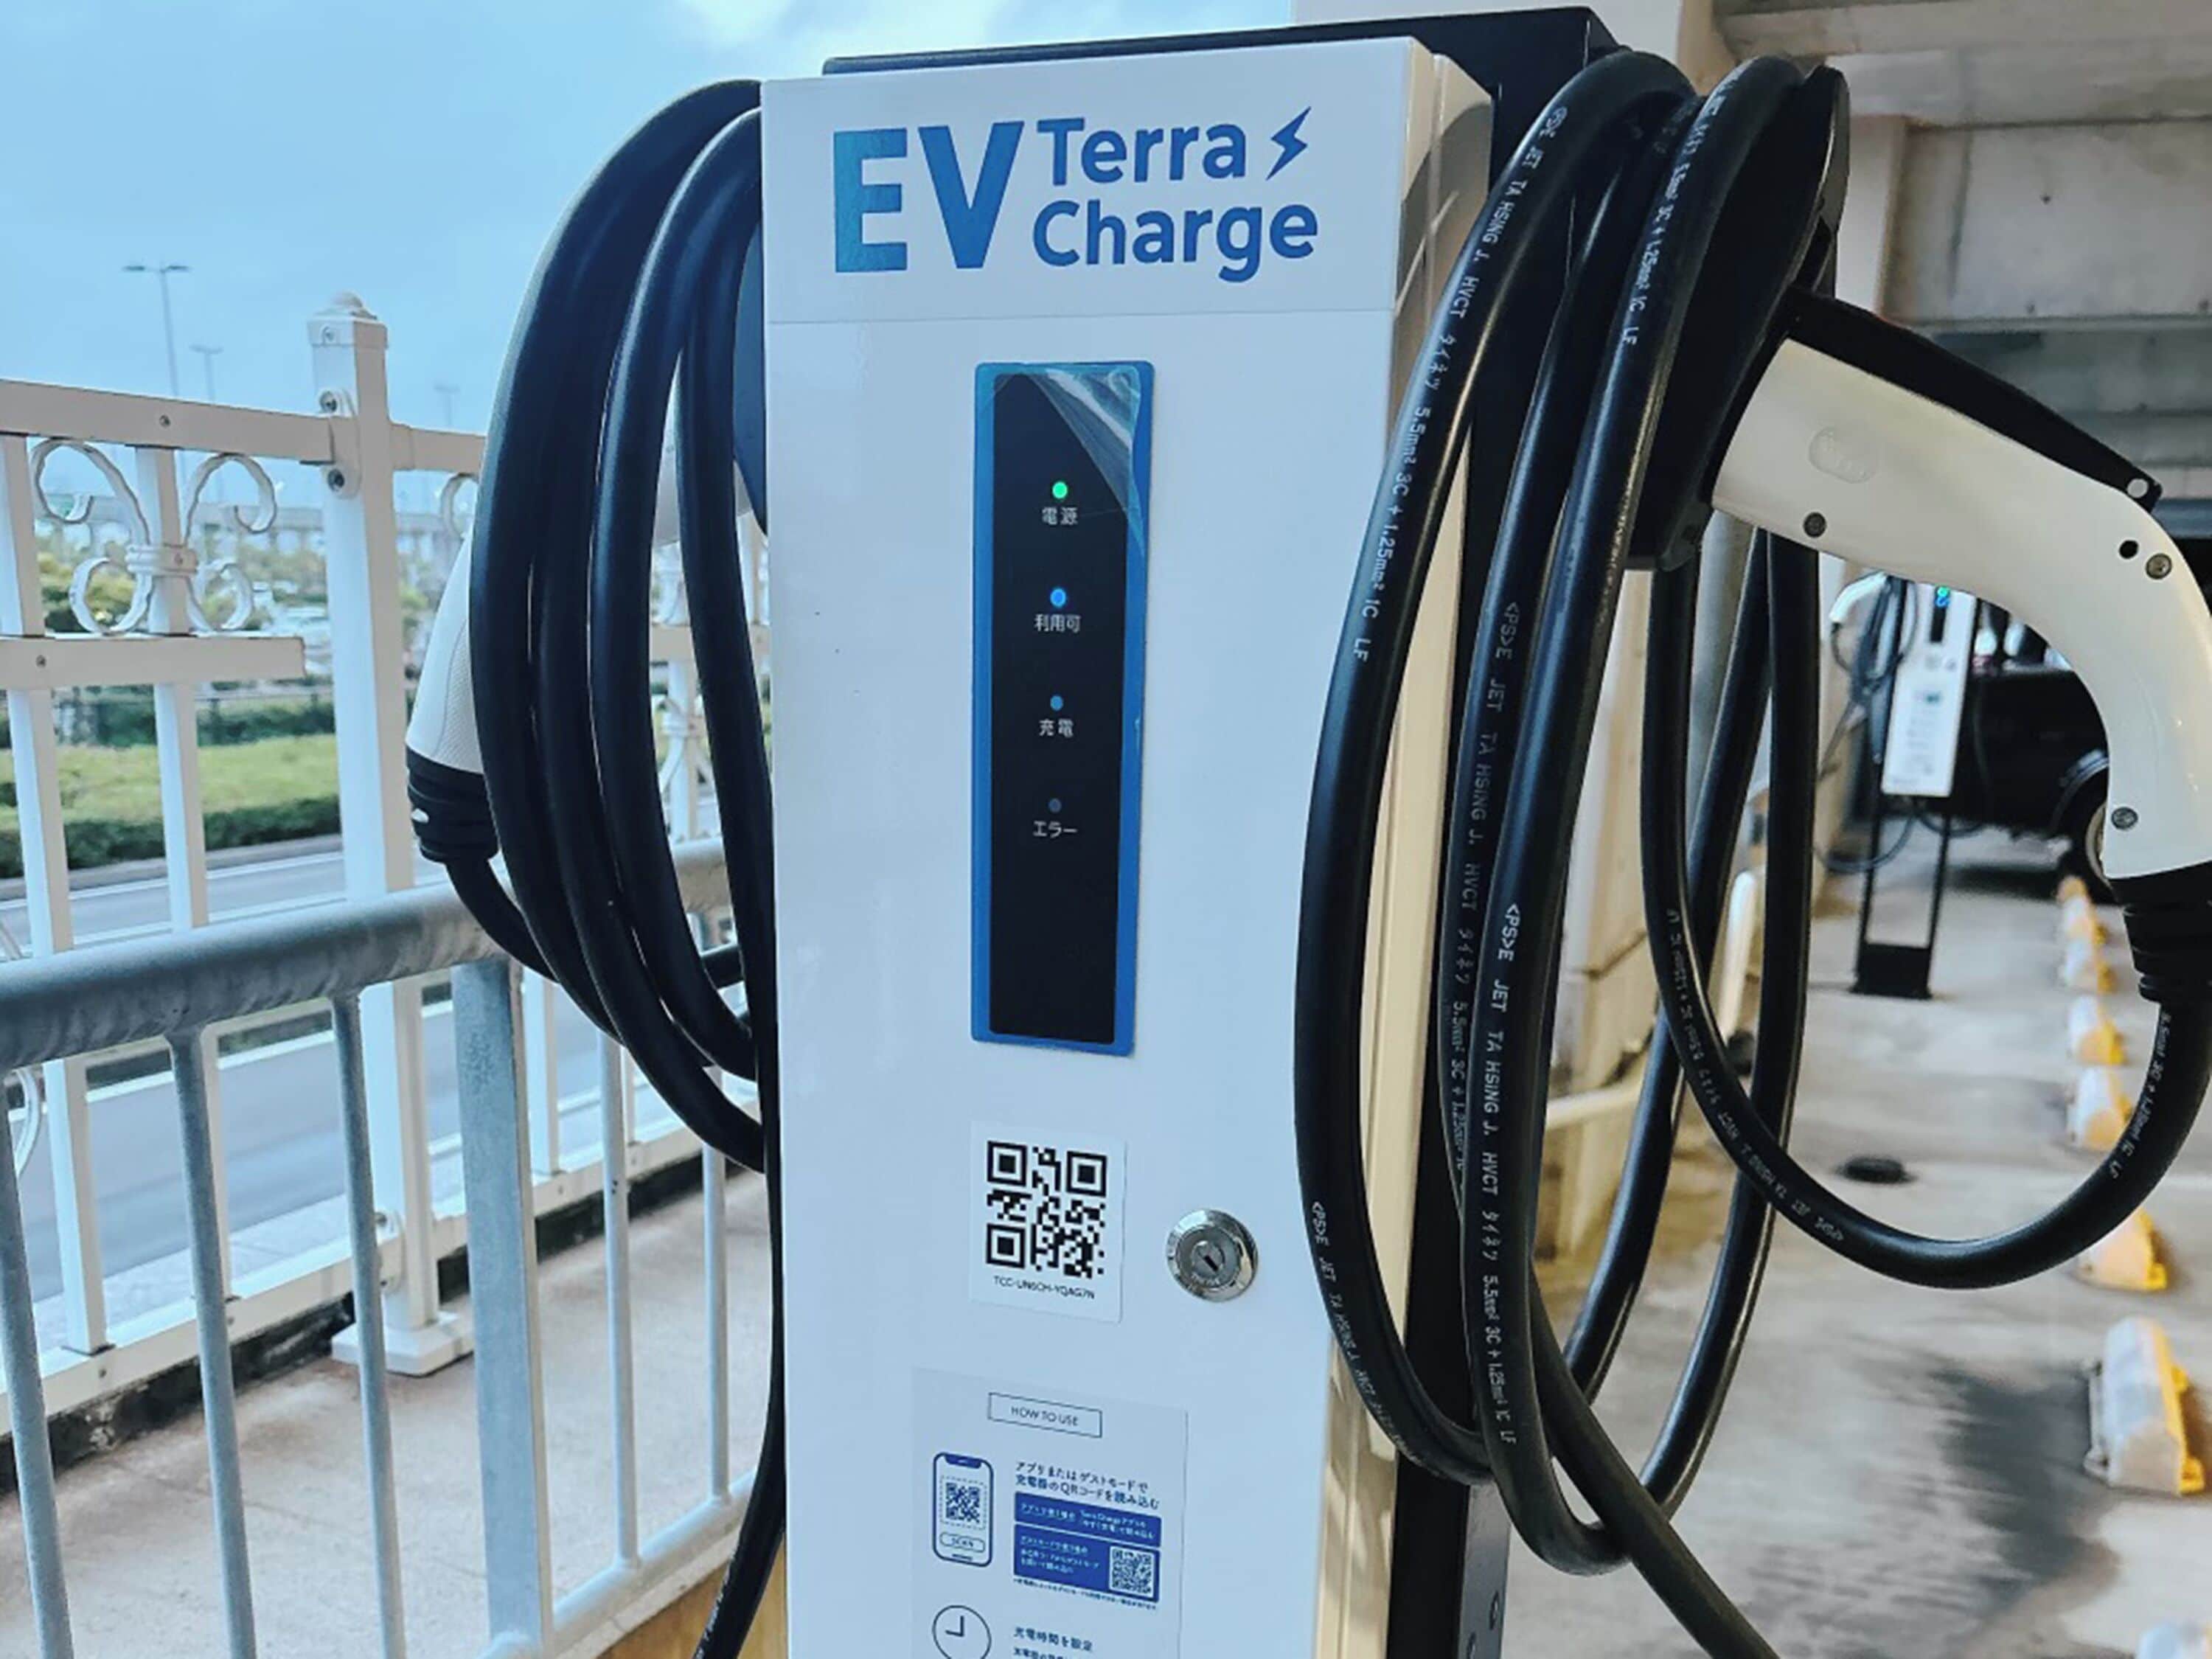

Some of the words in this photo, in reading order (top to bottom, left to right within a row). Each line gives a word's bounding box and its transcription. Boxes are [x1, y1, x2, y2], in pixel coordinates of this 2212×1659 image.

[1037, 116, 1246, 187] Terra
[1522, 145, 1544, 169] JET
[833, 121, 1025, 273] EV
[1505, 180, 1528, 195] TA
[1483, 201, 1514, 243] HSING
[1033, 198, 1318, 283] Charge
[1450, 276, 1480, 319] HVCT
[1392, 472, 1413, 496] 3C
[1042, 507, 1078, 525] 電源
[1362, 599, 1381, 619] 1C
[1034, 613, 1082, 633] 利用可
[1353, 637, 1371, 662] LF
[1486, 678, 1506, 712] JET
[1039, 718, 1074, 738] 充電
[1478, 732, 1498, 755] TA
[1471, 763, 1492, 821] HSING
[1033, 820, 1078, 838] エラー
[1462, 863, 1480, 911] HVCT
[1498, 903, 1520, 961] <PS>E
[1492, 979, 1510, 1012] JET
[1486, 1031, 1505, 1052] TA
[1484, 1060, 1501, 1113] HSING
[1482, 1152, 1499, 1196] HVCT
[1484, 1326, 1502, 1345] 3C
[1011, 1405, 1040, 1419] HOW
[1042, 1411, 1057, 1422] TO
[1059, 1415, 1079, 1427] USE
[1500, 1430, 1517, 1444] LF
